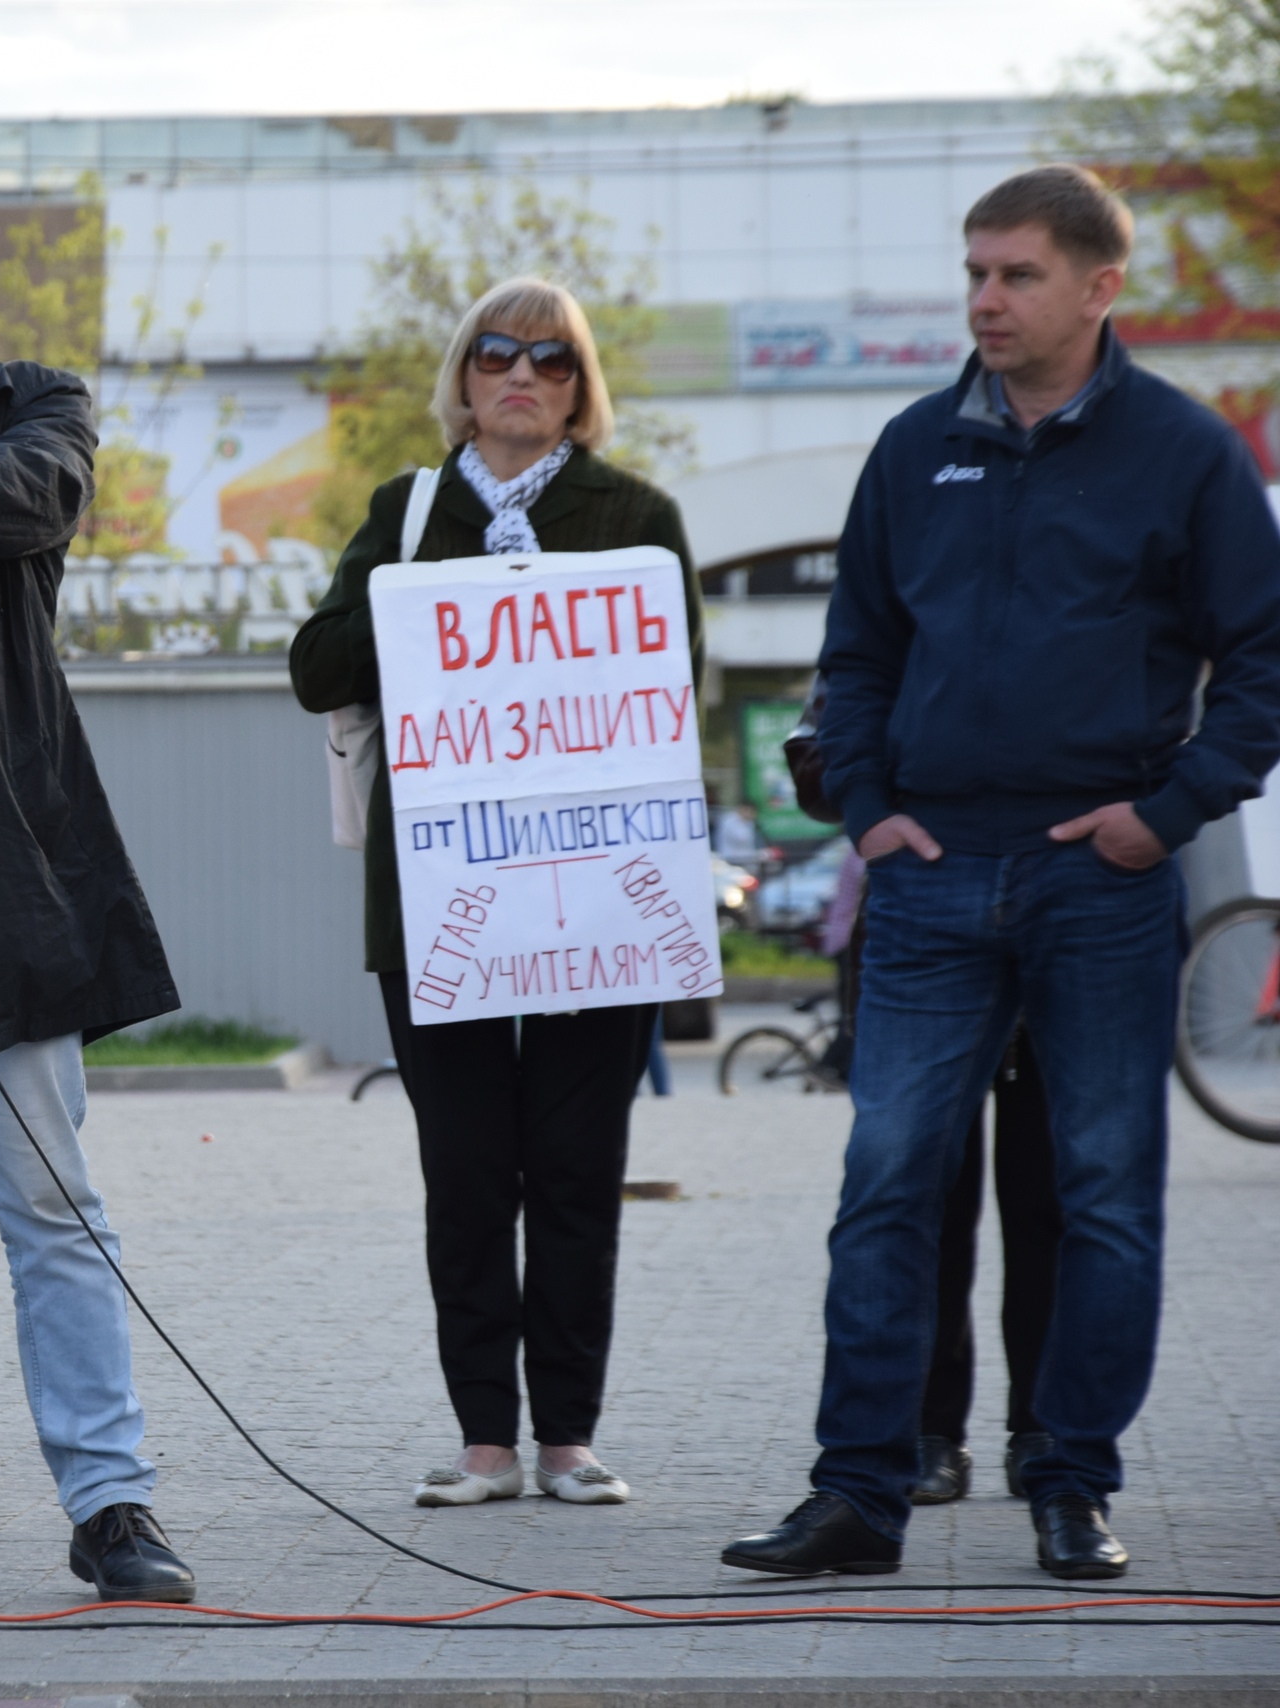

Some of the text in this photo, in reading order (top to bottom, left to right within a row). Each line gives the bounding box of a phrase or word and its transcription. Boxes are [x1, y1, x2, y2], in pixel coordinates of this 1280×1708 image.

[436, 585, 668, 671] ВЛАСТЬ
[392, 699, 493, 772] ДАЙ
[504, 685, 692, 761] ЗАЩИТУ
[414, 884, 497, 1009] ОСТАВЬ
[614, 854, 724, 997] КВАРТИРЫ
[474, 944, 659, 1000] УЧИТЕЛЯМ
